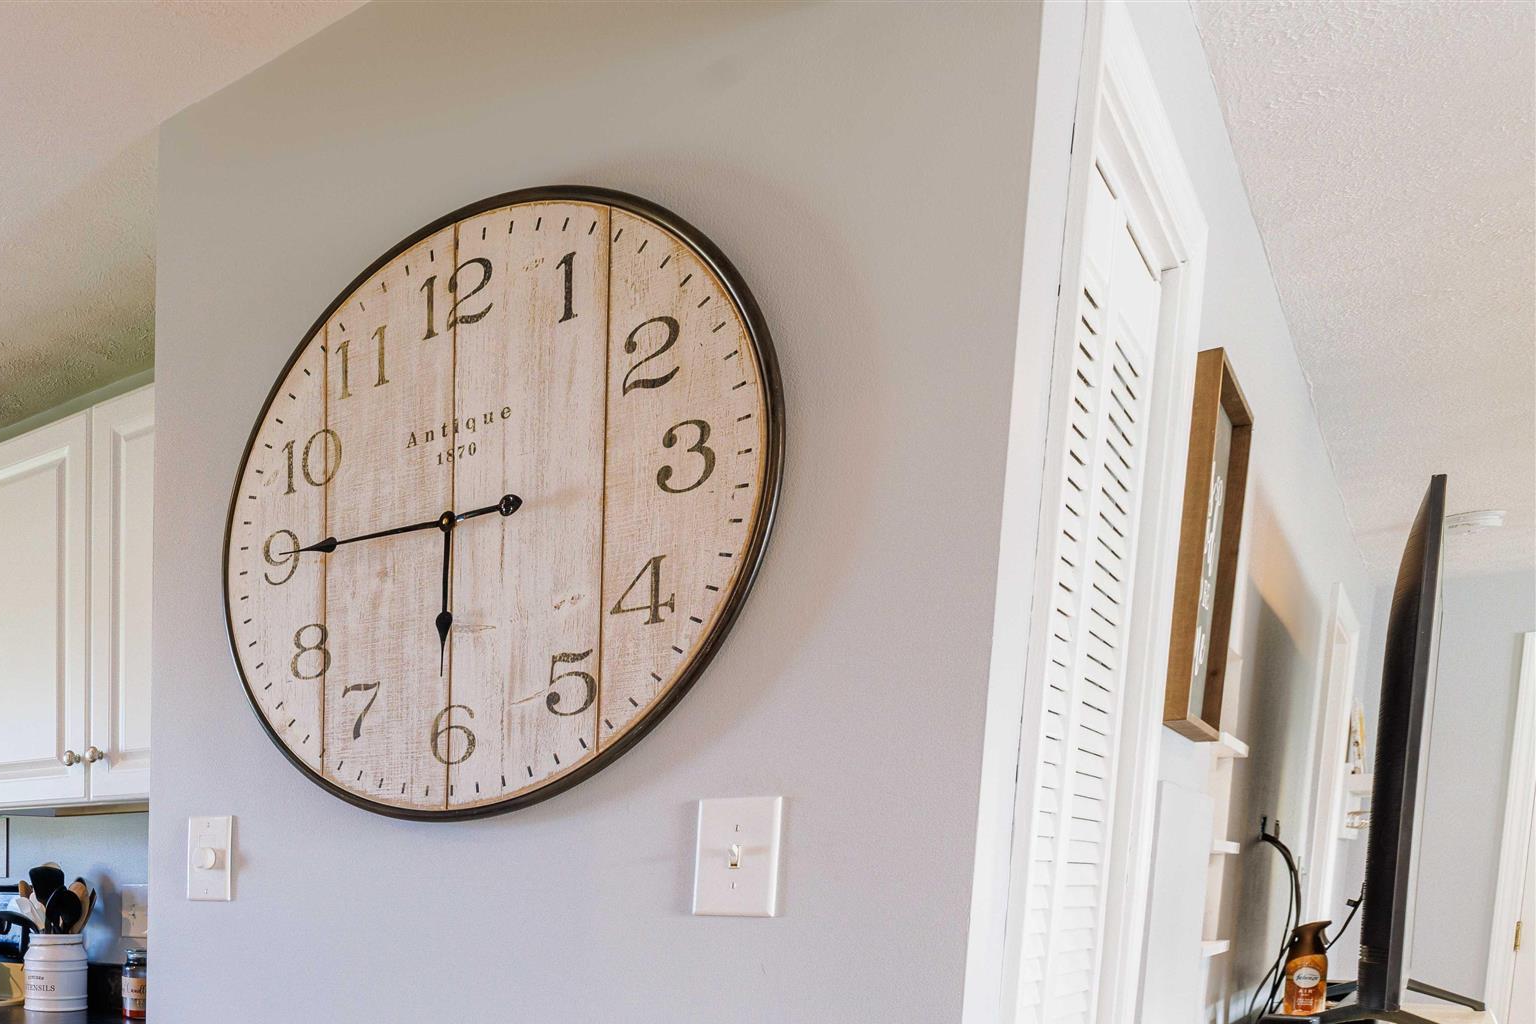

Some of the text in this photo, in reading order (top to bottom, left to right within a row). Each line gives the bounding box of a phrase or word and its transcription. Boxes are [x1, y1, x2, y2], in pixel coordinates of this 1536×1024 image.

[420, 257, 494, 340] 12
[557, 251, 578, 323] 1
[335, 325, 390, 401] 11
[623, 316, 680, 397] 2
[406, 406, 512, 449] Antique
[437, 441, 477, 466] 1870
[657, 419, 716, 495] 3
[282, 428, 343, 496] 10
[263, 529, 300, 586] 9
[610, 554, 676, 626] 4
[290, 623, 332, 681] 8
[546, 648, 598, 717] 5
[342, 681, 380, 741] 7
[430, 704, 477, 765] 6
